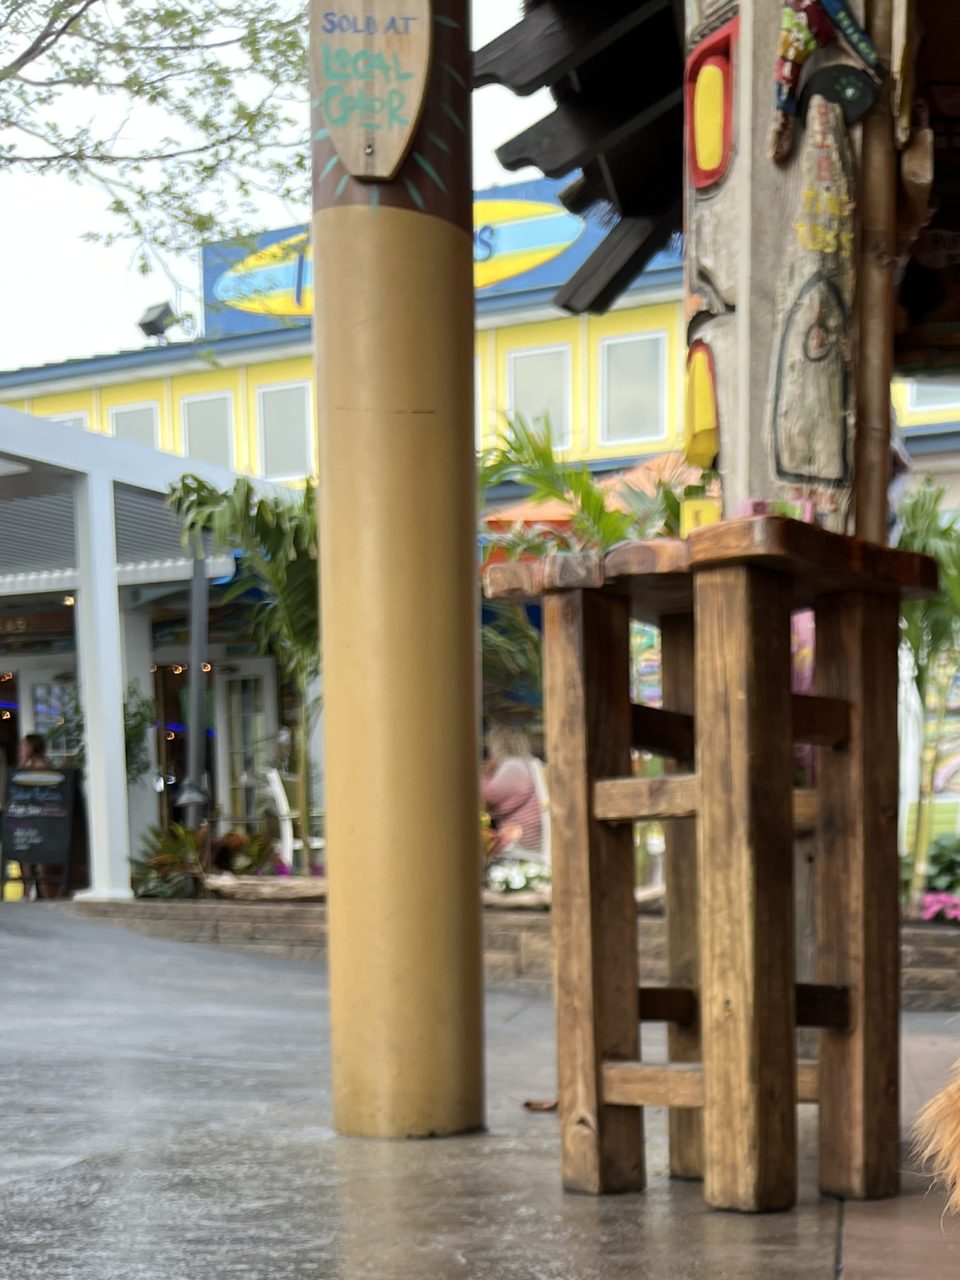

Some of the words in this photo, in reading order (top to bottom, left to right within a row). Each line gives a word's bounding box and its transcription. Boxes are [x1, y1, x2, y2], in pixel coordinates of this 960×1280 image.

[321, 12, 378, 35] SOLD
[384, 16, 418, 35] AT
[322, 44, 414, 82] LOCAL
[322, 85, 409, 130] COLOR
